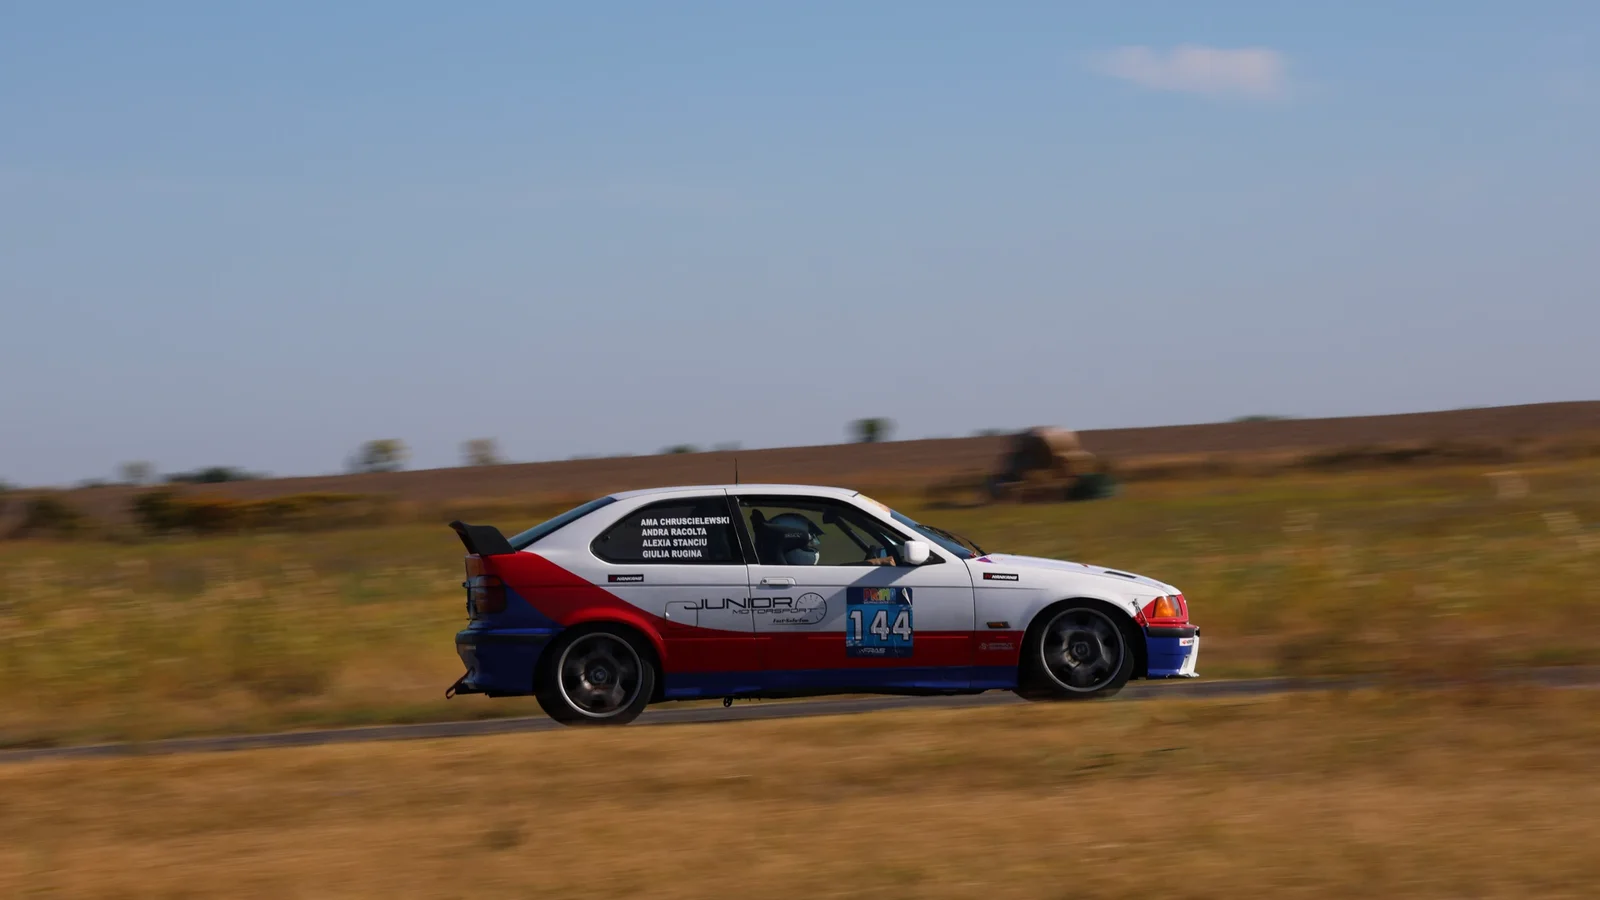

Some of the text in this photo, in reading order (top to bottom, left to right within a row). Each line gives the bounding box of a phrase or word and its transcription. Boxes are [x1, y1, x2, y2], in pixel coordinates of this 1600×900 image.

[641, 516, 730, 526] AMA CHRUSCIELEWSKI
[641, 527, 707, 536] ANDRA RACOLTA
[642, 538, 707, 547] ALEXIA STANCIU
[642, 549, 702, 558] GIULIA RUGINA
[684, 596, 793, 609] JUNIOR
[732, 607, 817, 615] MOTORSPORT
[850, 609, 912, 641] 144
